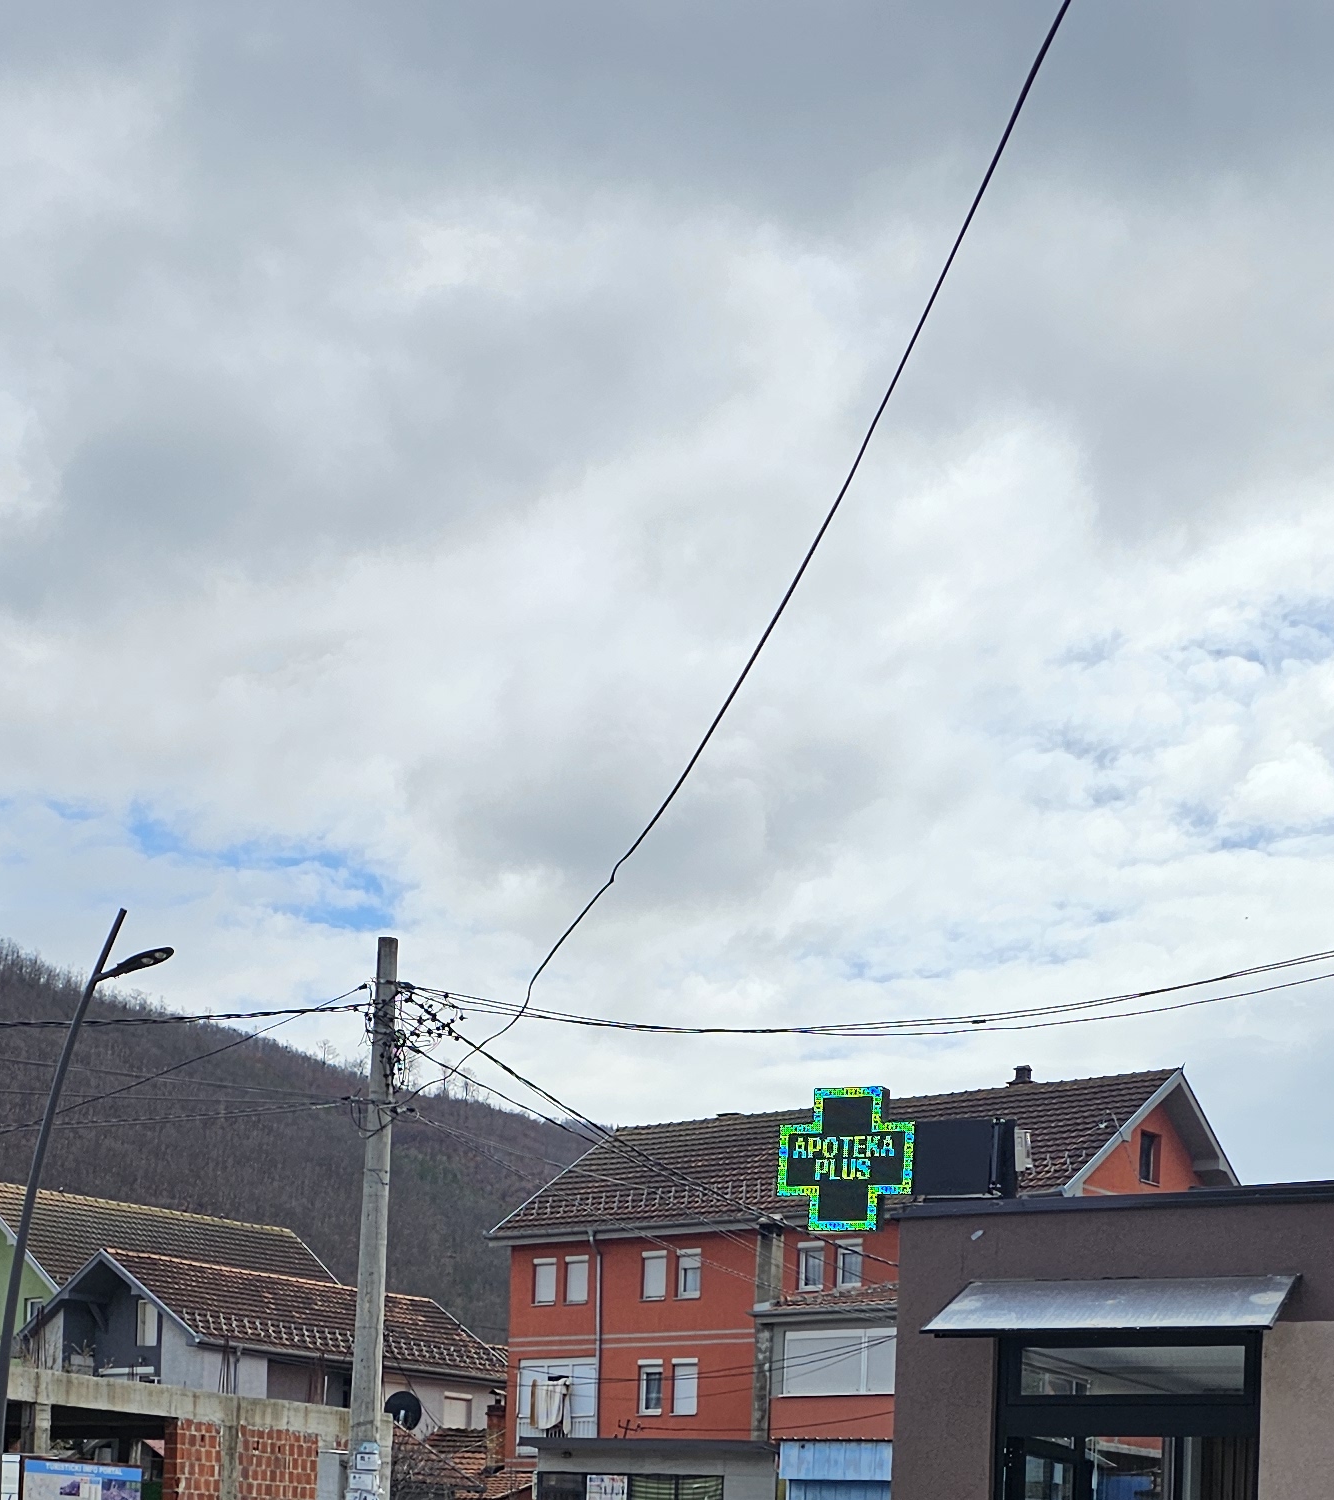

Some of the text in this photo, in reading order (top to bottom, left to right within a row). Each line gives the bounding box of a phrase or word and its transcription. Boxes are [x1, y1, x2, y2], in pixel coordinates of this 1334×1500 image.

[793, 1136, 895, 1158] APOTEKA
[814, 1159, 871, 1180] PLUS
[99, 1465, 123, 1476] PORTAL
